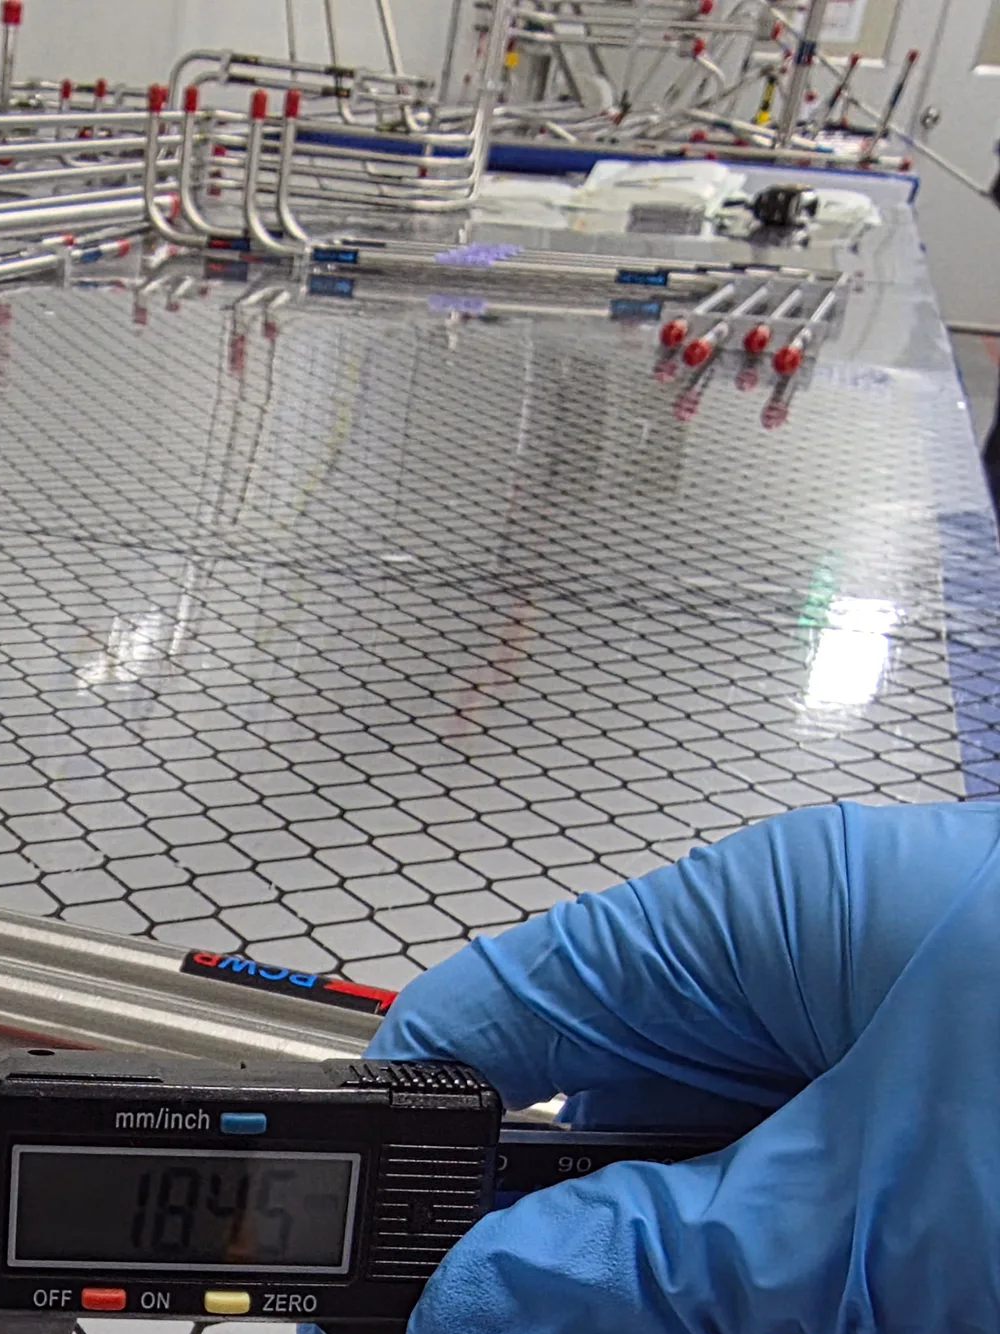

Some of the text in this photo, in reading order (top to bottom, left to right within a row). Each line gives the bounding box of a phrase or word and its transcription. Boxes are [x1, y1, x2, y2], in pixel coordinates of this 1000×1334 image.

[115, 1108, 211, 1130] mm/inch
[557, 1156, 593, 1172] 90
[33, 1290, 318, 1313] OFF ON ZERO
